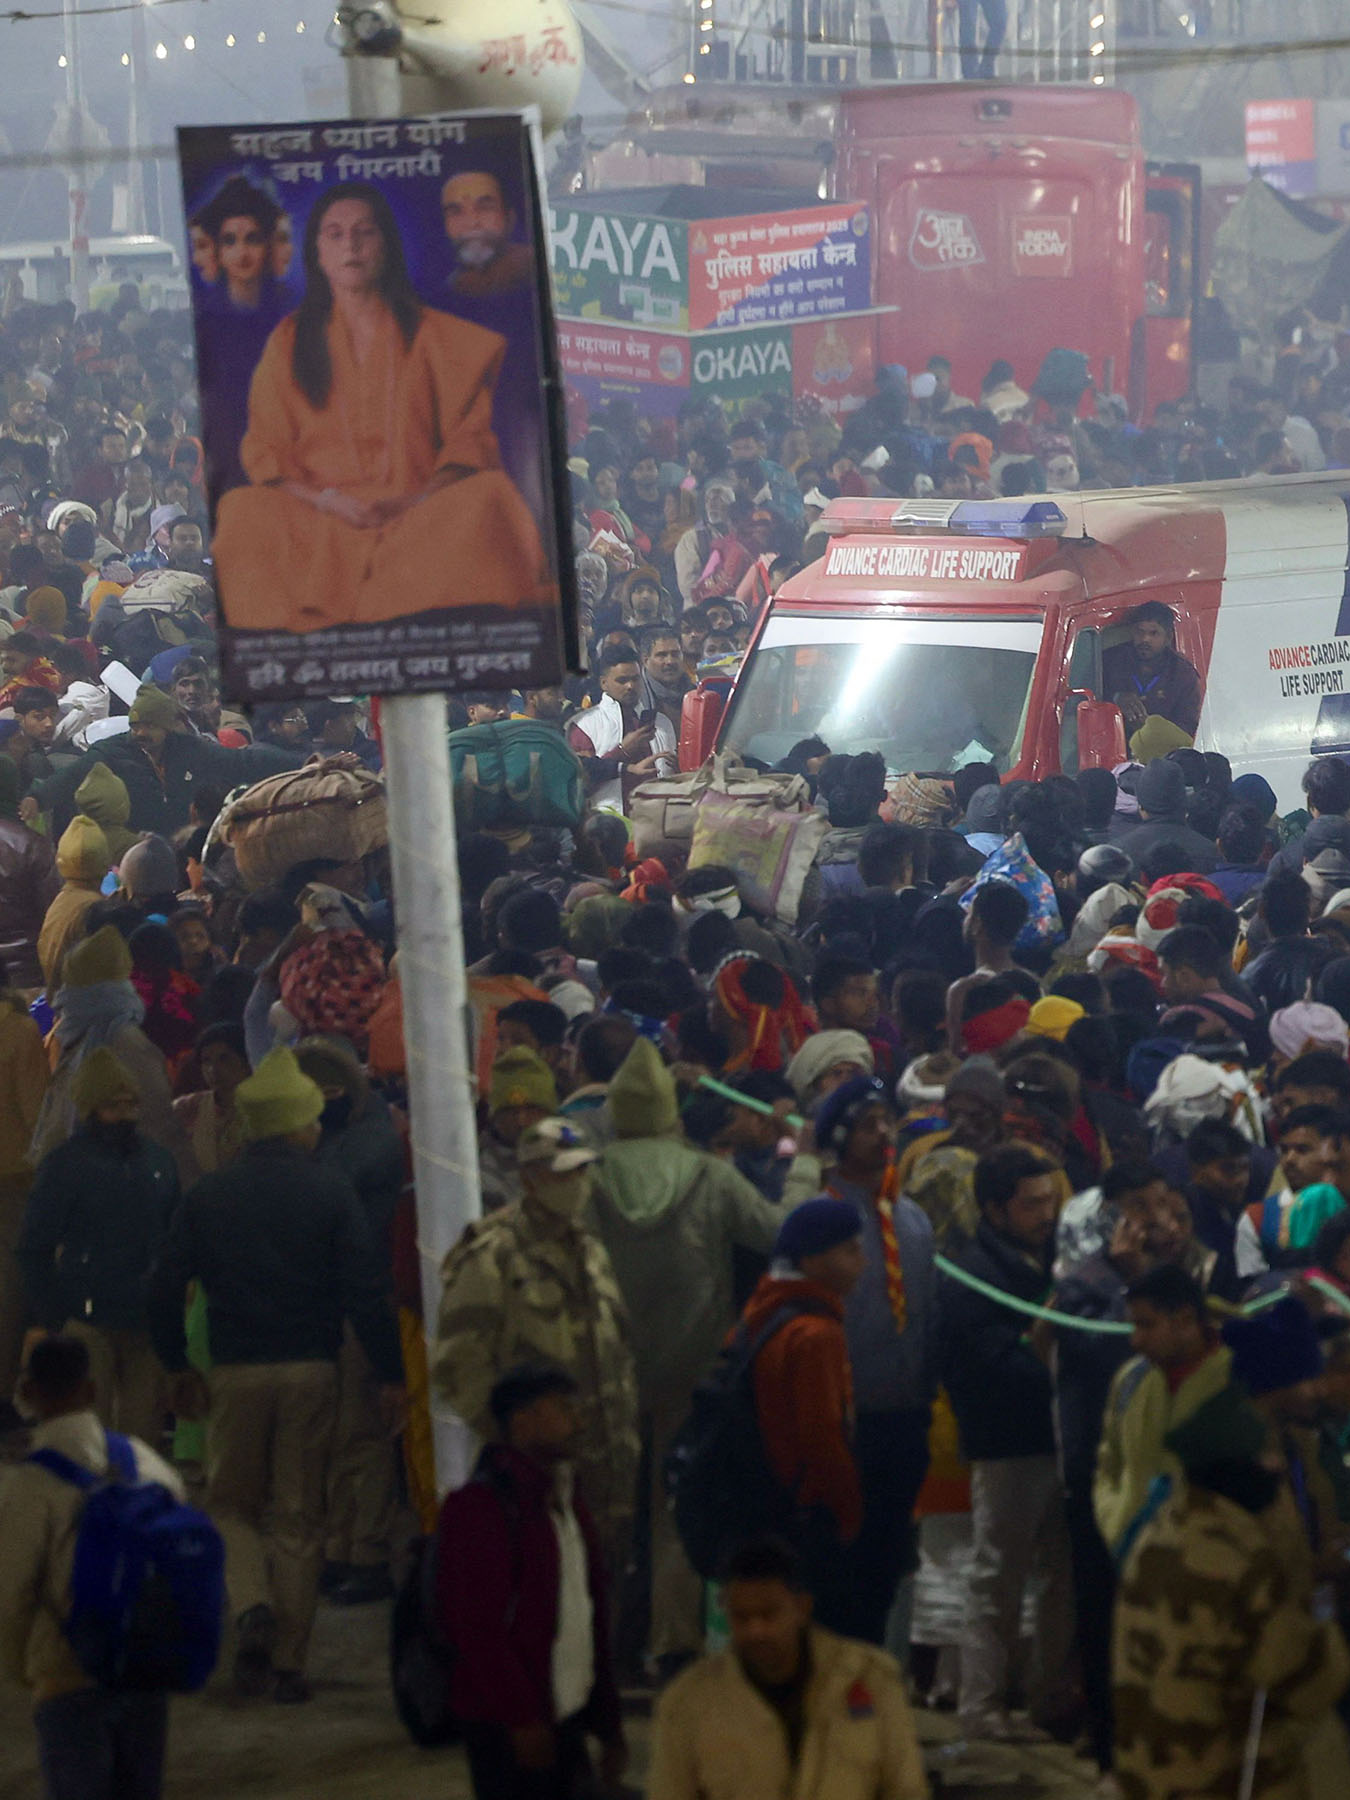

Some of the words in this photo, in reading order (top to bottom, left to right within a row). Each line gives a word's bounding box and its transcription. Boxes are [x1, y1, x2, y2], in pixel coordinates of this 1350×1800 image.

[230, 129, 312, 159] सहज
[405, 119, 466, 146] योग
[271, 161, 324, 184] जय
[335, 150, 443, 180] गिरनारी
[548, 210, 681, 283] KAYA
[918, 214, 964, 248] आज
[1023, 230, 1060, 242] INDIA
[938, 236, 977, 262] तक
[1017, 241, 1067, 256] TODAY
[705, 248, 753, 290] पुलिस
[757, 248, 819, 276] सहायता
[575, 336, 621, 355] सहायता
[693, 340, 792, 384] OKAYA
[826, 547, 877, 576] ADVANCE
[878, 547, 929, 577] CARDIAC
[930, 550, 958, 579] LIFE
[960, 551, 1021, 580] SUPPORT
[405, 656, 449, 676] जय
[1280, 674, 1301, 698] LIFE
[1302, 669, 1344, 696] SUPPORT
